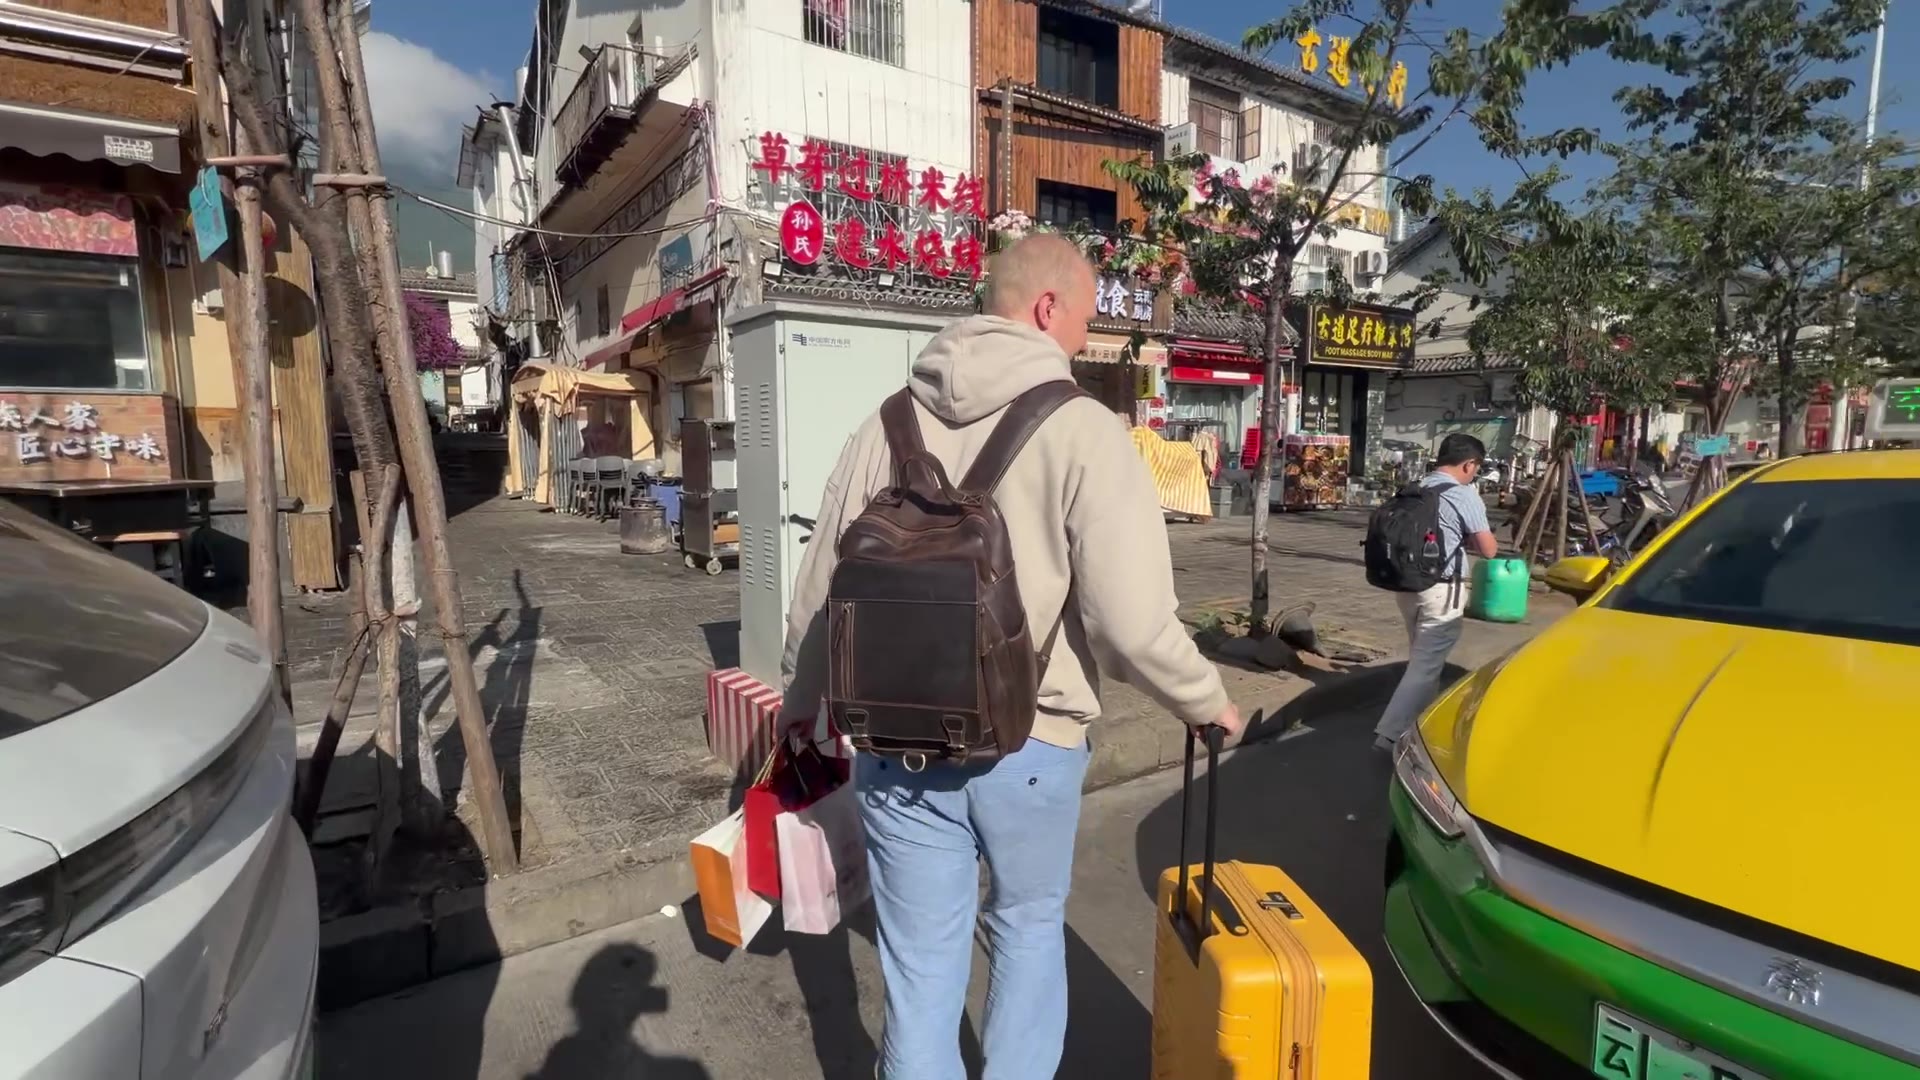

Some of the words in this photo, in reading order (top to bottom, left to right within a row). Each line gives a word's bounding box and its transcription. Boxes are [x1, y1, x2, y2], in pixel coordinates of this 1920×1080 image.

[752, 131, 986, 219] 草芽过桥米线
[791, 209, 813, 258] 孙氏
[833, 217, 985, 281] 建水烧烤
[1325, 346, 1339, 355] FOOT
[17, 432, 162, 465] 匠心守味
